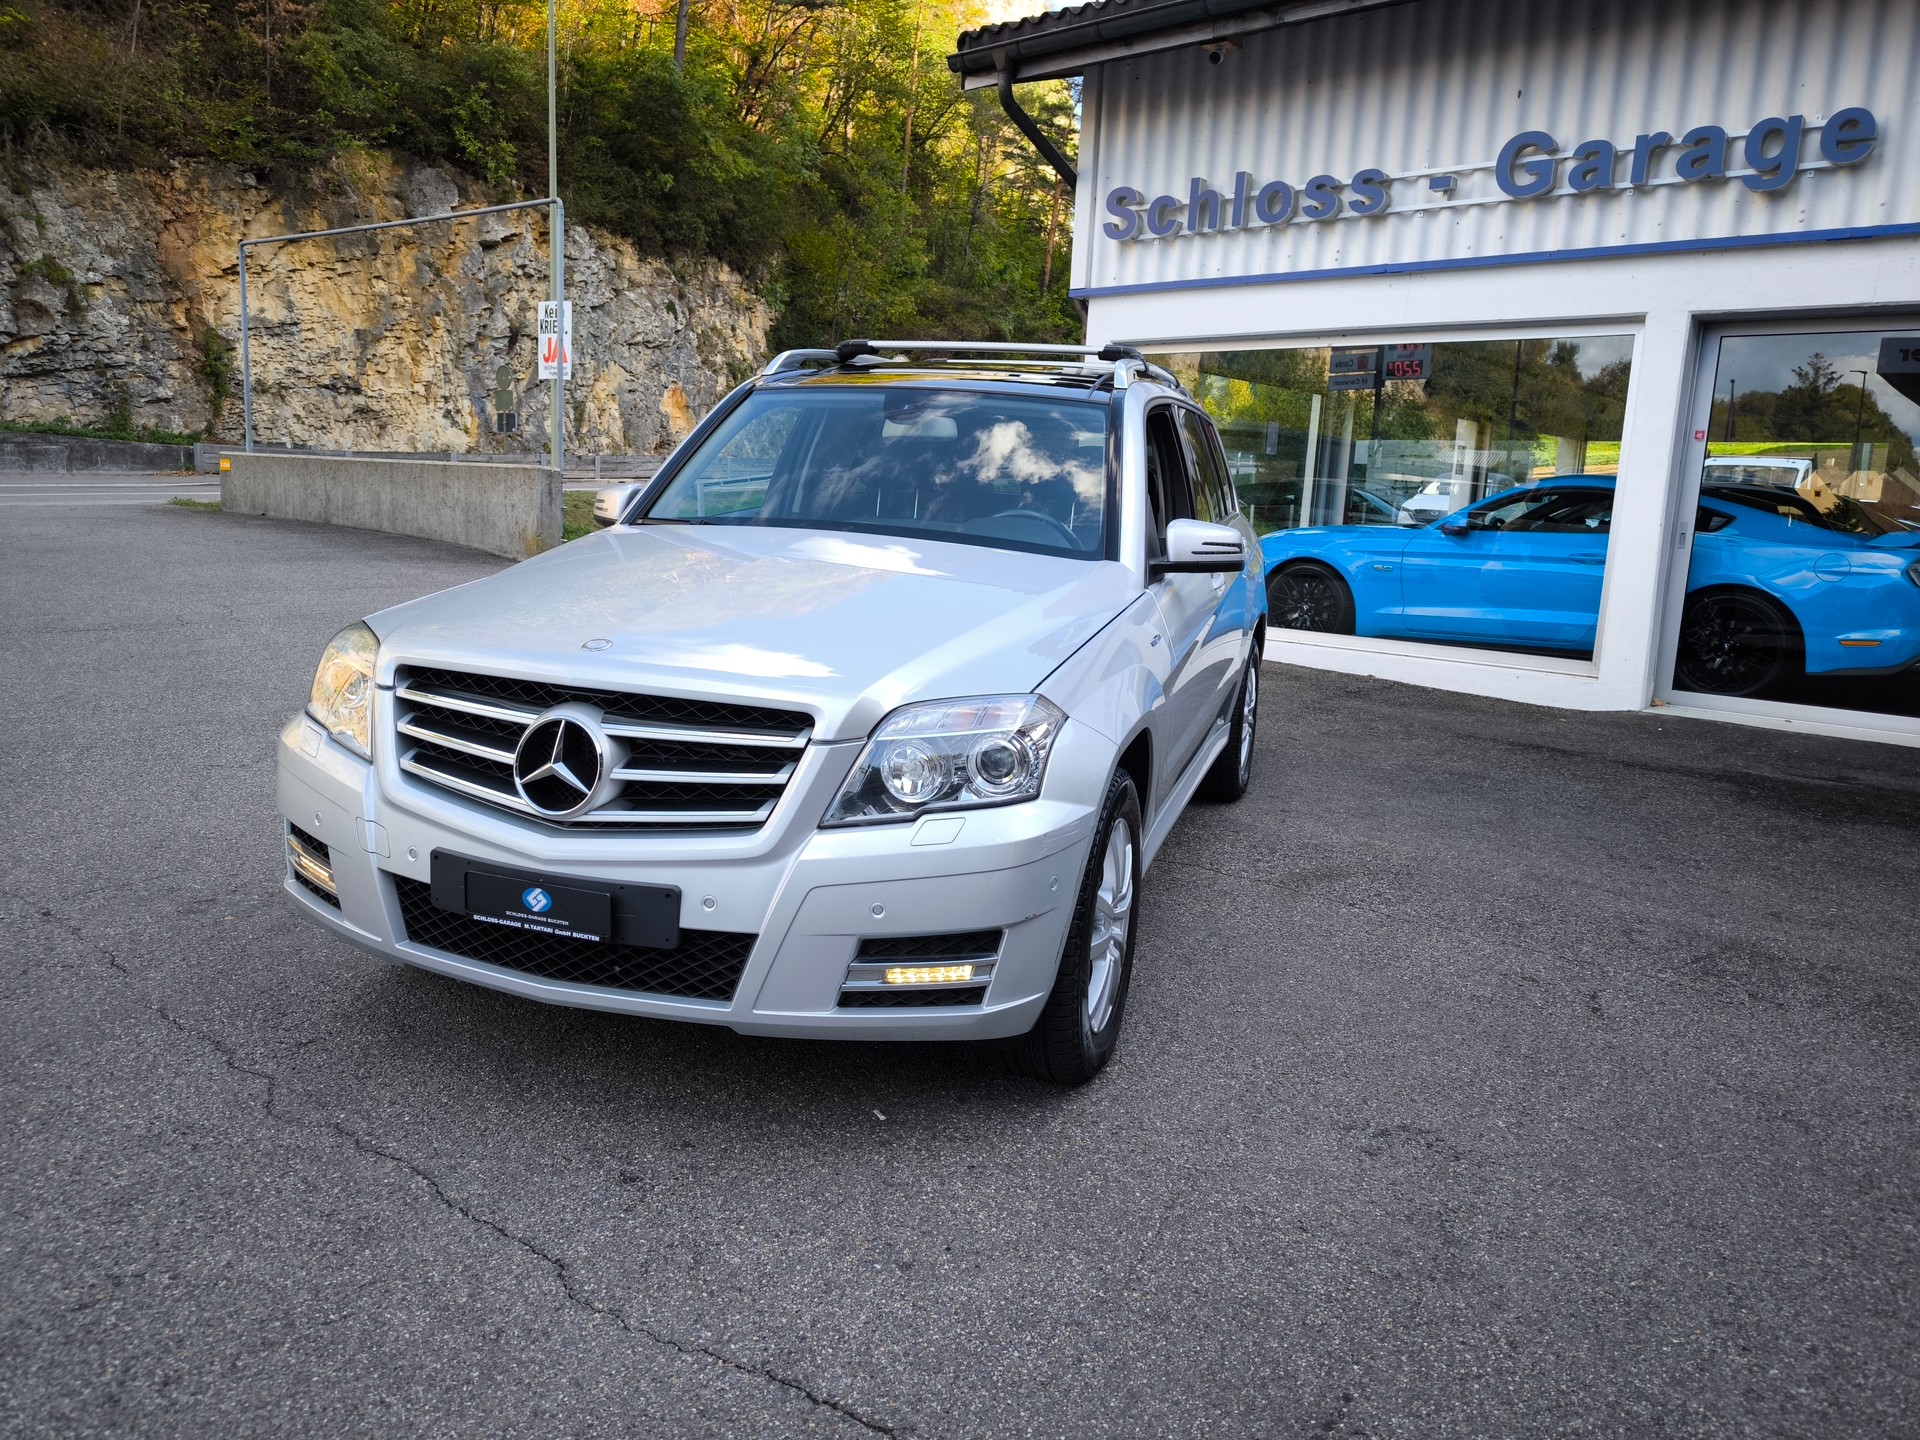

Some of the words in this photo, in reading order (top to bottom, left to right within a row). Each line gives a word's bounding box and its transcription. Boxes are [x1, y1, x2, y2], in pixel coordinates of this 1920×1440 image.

[1102, 168, 1391, 242] Schloss
[1494, 106, 1879, 199] Garage
[544, 304, 564, 318] Kei
[540, 319, 568, 335] KRIE.
[543, 337, 568, 363] JA
[473, 914, 522, 928] SCHLOSS-GARAGE
[554, 929, 571, 937] GmbH
[572, 932, 600, 942] BUCKTEN
[506, 911, 547, 922] SCHLOSS-GARAGE
[548, 918, 569, 926] BUCKTEN
